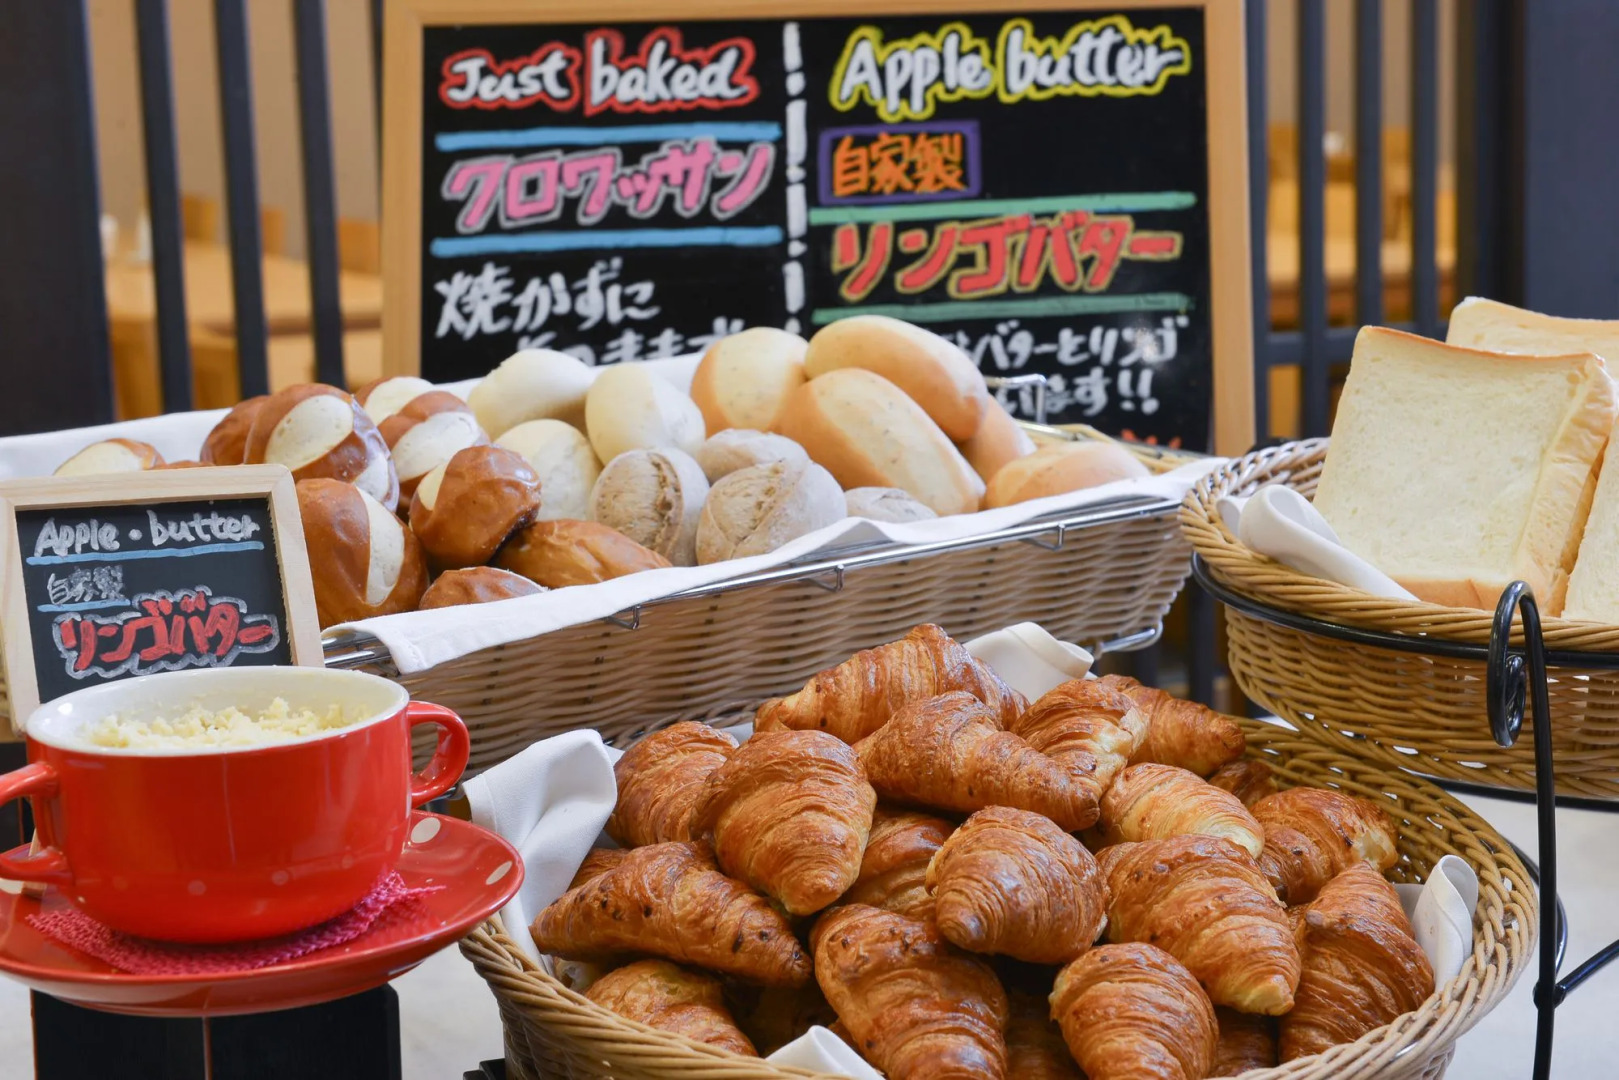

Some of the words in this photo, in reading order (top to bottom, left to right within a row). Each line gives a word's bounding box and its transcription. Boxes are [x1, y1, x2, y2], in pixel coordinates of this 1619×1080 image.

[443, 46, 575, 105] Just
[587, 33, 754, 112] baked
[836, 27, 995, 117] Apple
[1002, 21, 1187, 98] butter
[441, 137, 775, 232] クロワッサン
[833, 132, 968, 196] 自家製
[833, 211, 1182, 298] リンゴバター
[434, 257, 661, 340] 焼かずに
[56, 588, 277, 676] リンゴバター
